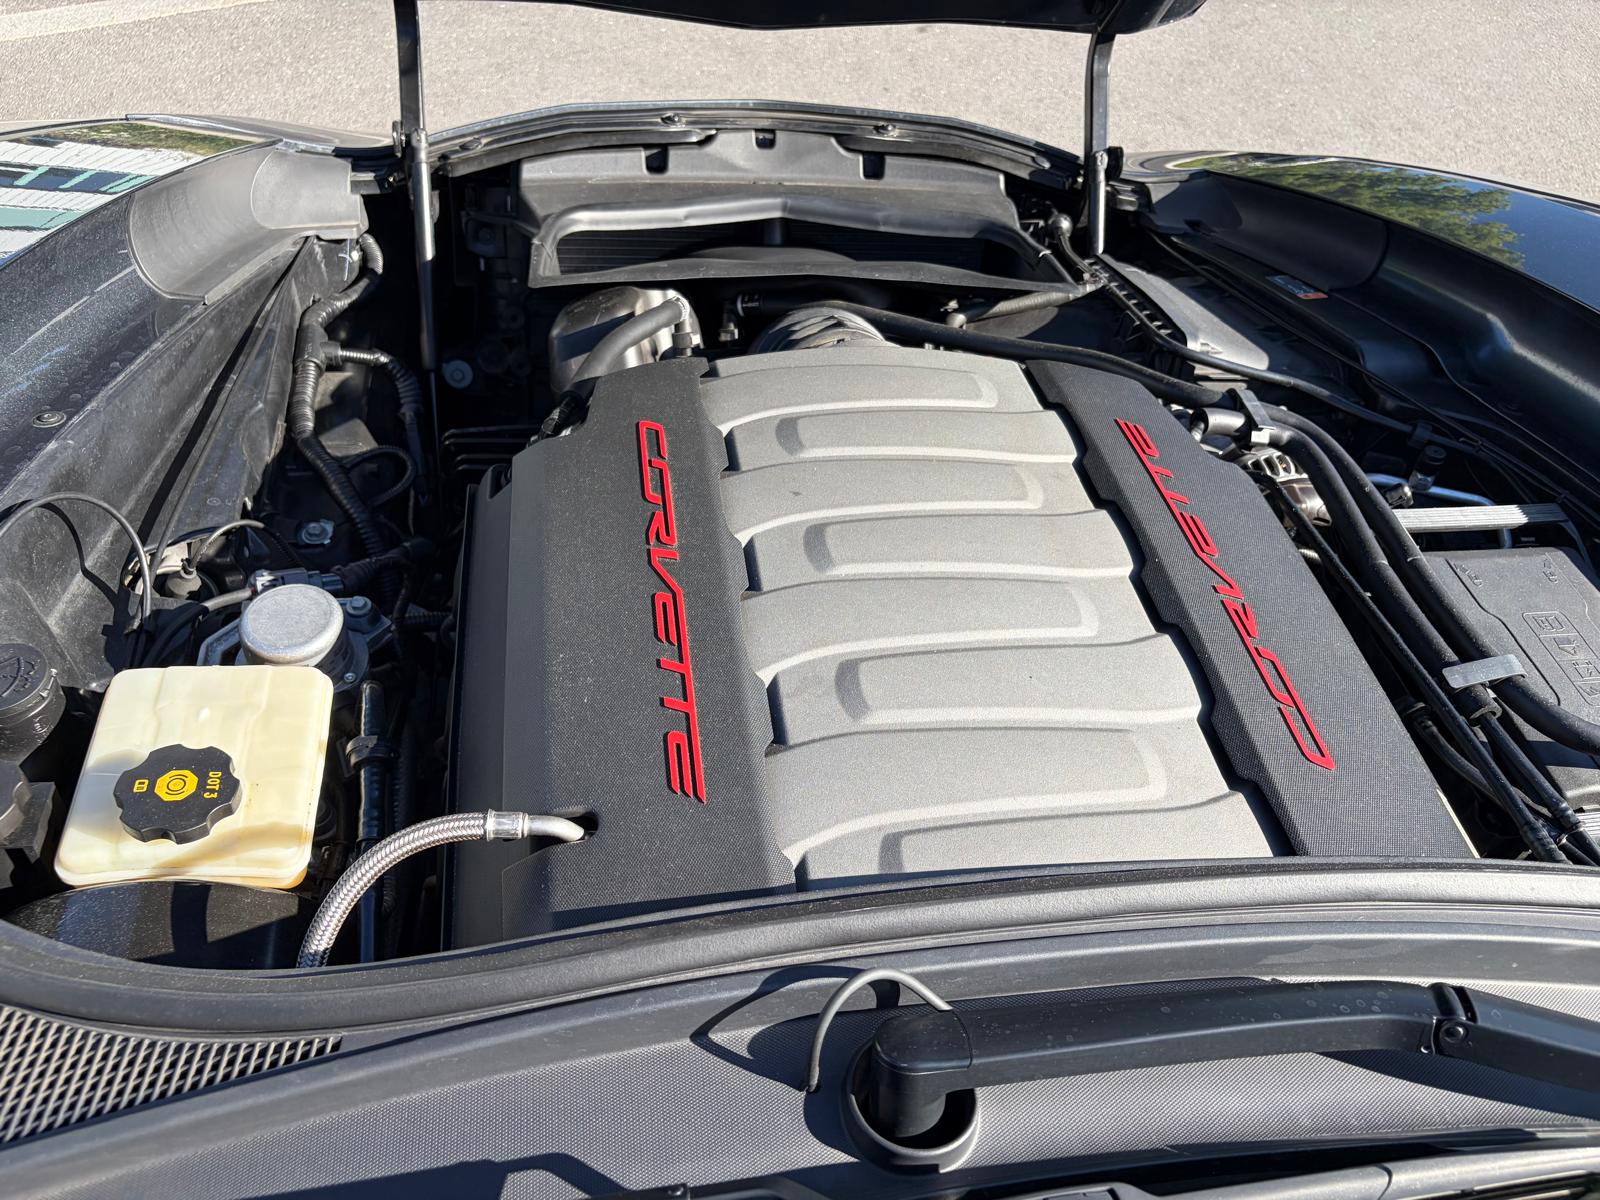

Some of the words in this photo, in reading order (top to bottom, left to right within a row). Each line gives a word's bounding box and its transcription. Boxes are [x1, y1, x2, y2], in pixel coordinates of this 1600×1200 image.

[638, 420, 706, 803] CORVETTE
[1115, 418, 1335, 770] CORVETTE
[206, 771, 222, 791] DOT
